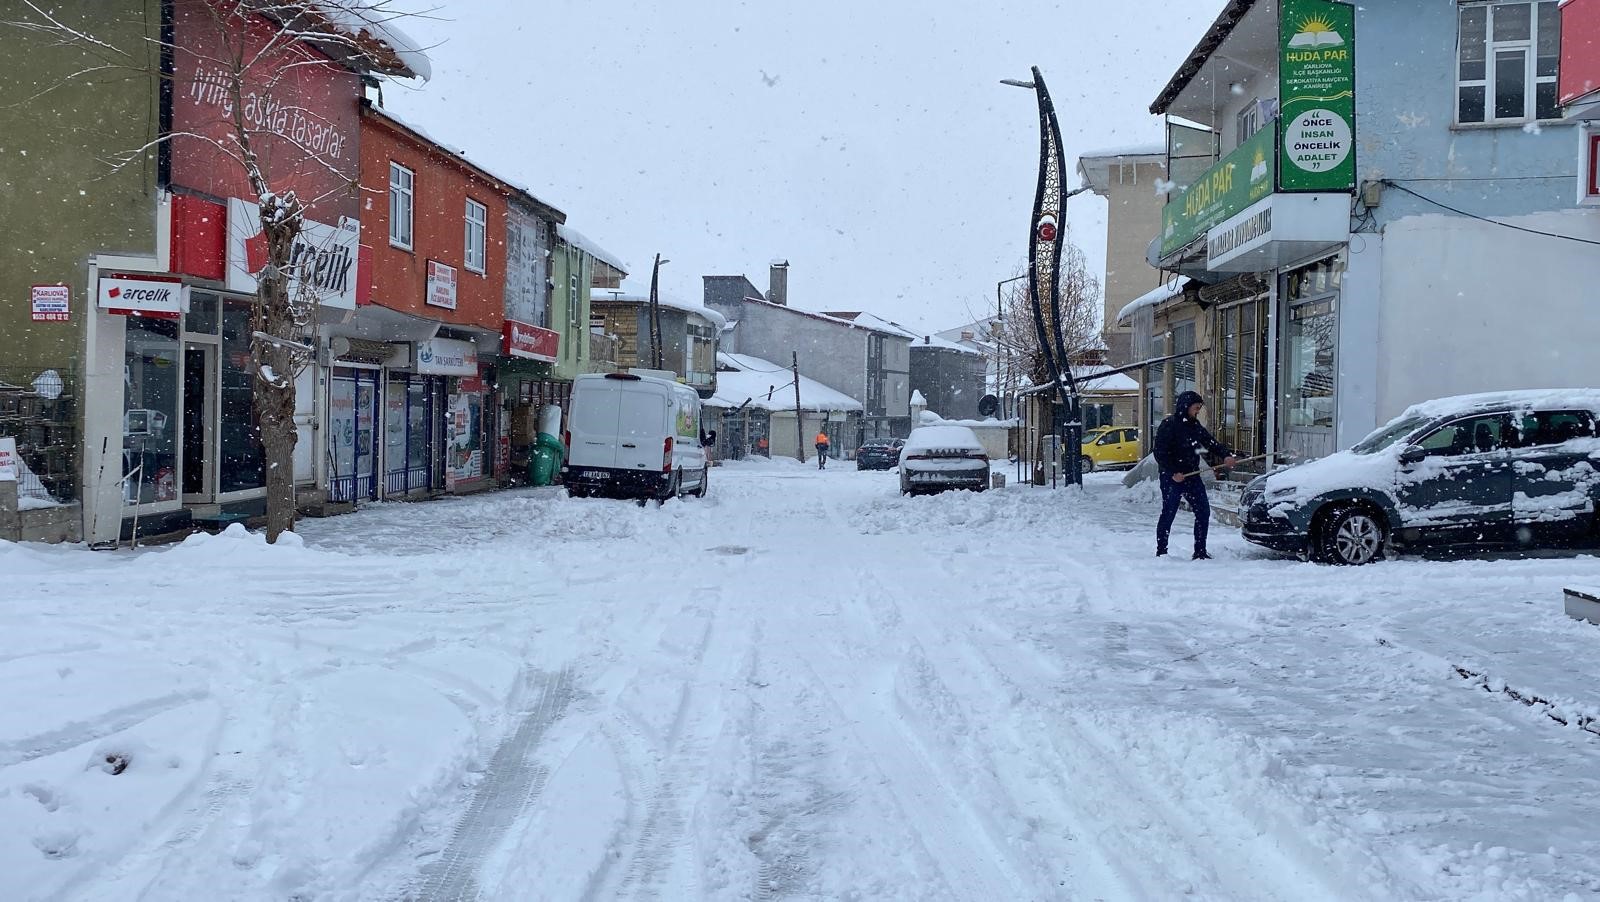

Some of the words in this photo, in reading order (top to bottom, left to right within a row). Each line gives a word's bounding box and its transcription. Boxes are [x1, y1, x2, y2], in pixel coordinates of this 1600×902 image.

[1324, 50, 1347, 61] PAR
[1302, 118, 1333, 127] ÖNCE
[291, 109, 346, 158] tasarlar
[1300, 129, 1334, 139] İNSAN
[1293, 141, 1341, 150] ÖNCELİK
[1296, 153, 1338, 162] ADALET
[1213, 162, 1233, 204] PAR
[122, 288, 171, 303] arçelik
[434, 355, 443, 366] TAN
